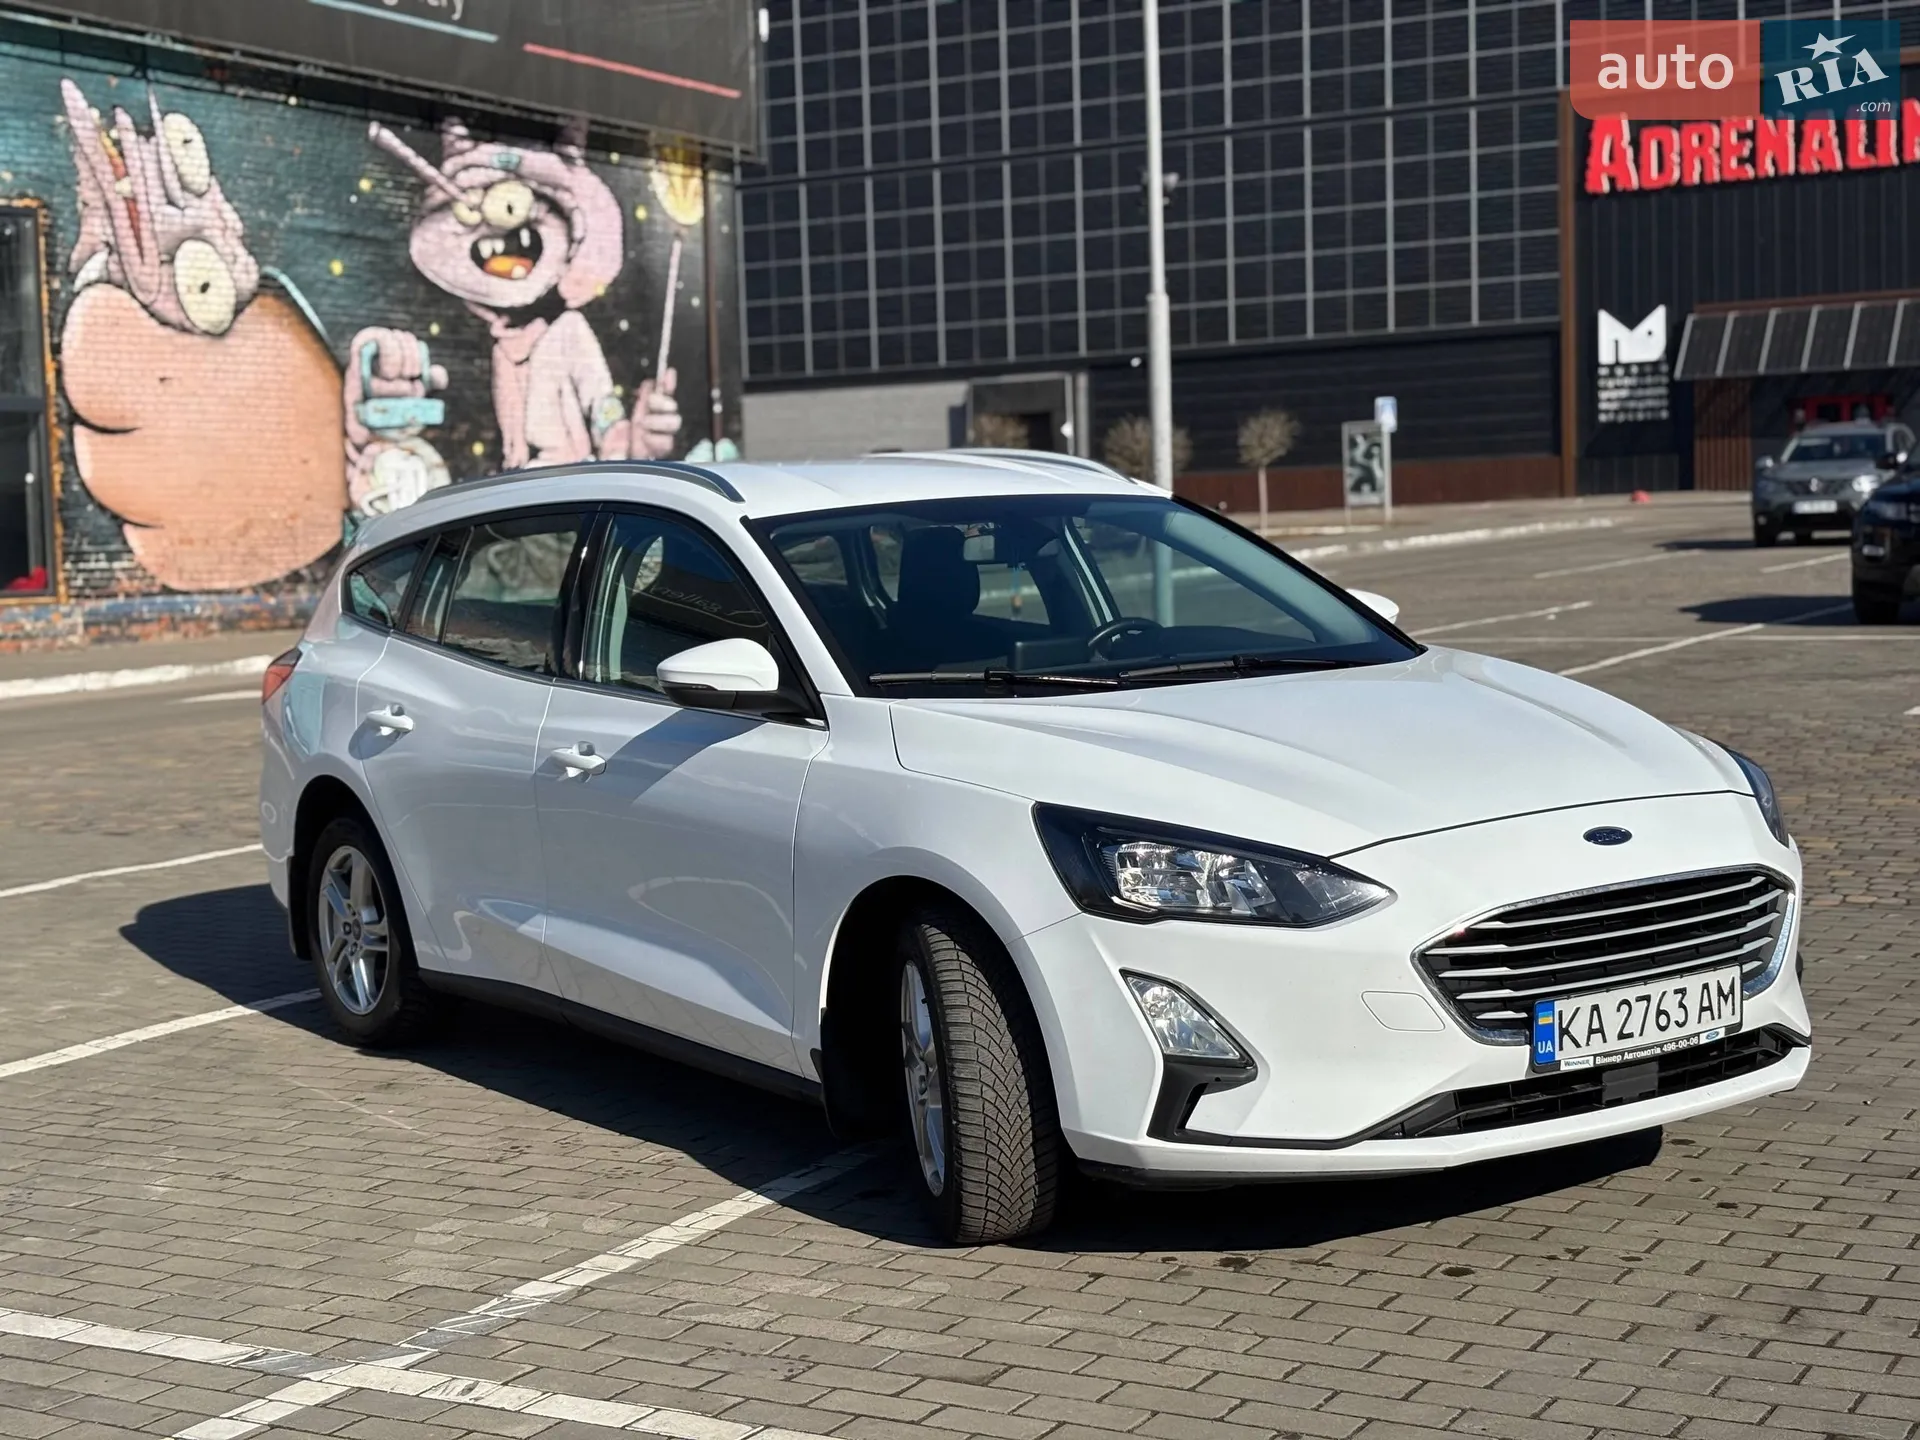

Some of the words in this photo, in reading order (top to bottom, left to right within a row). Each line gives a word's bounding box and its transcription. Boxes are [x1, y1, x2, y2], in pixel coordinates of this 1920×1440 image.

[1557, 1003, 1608, 1051] KA
[1616, 987, 1689, 1040] 2763
[1697, 976, 1736, 1025] AM
[1537, 1040, 1554, 1054] UA
